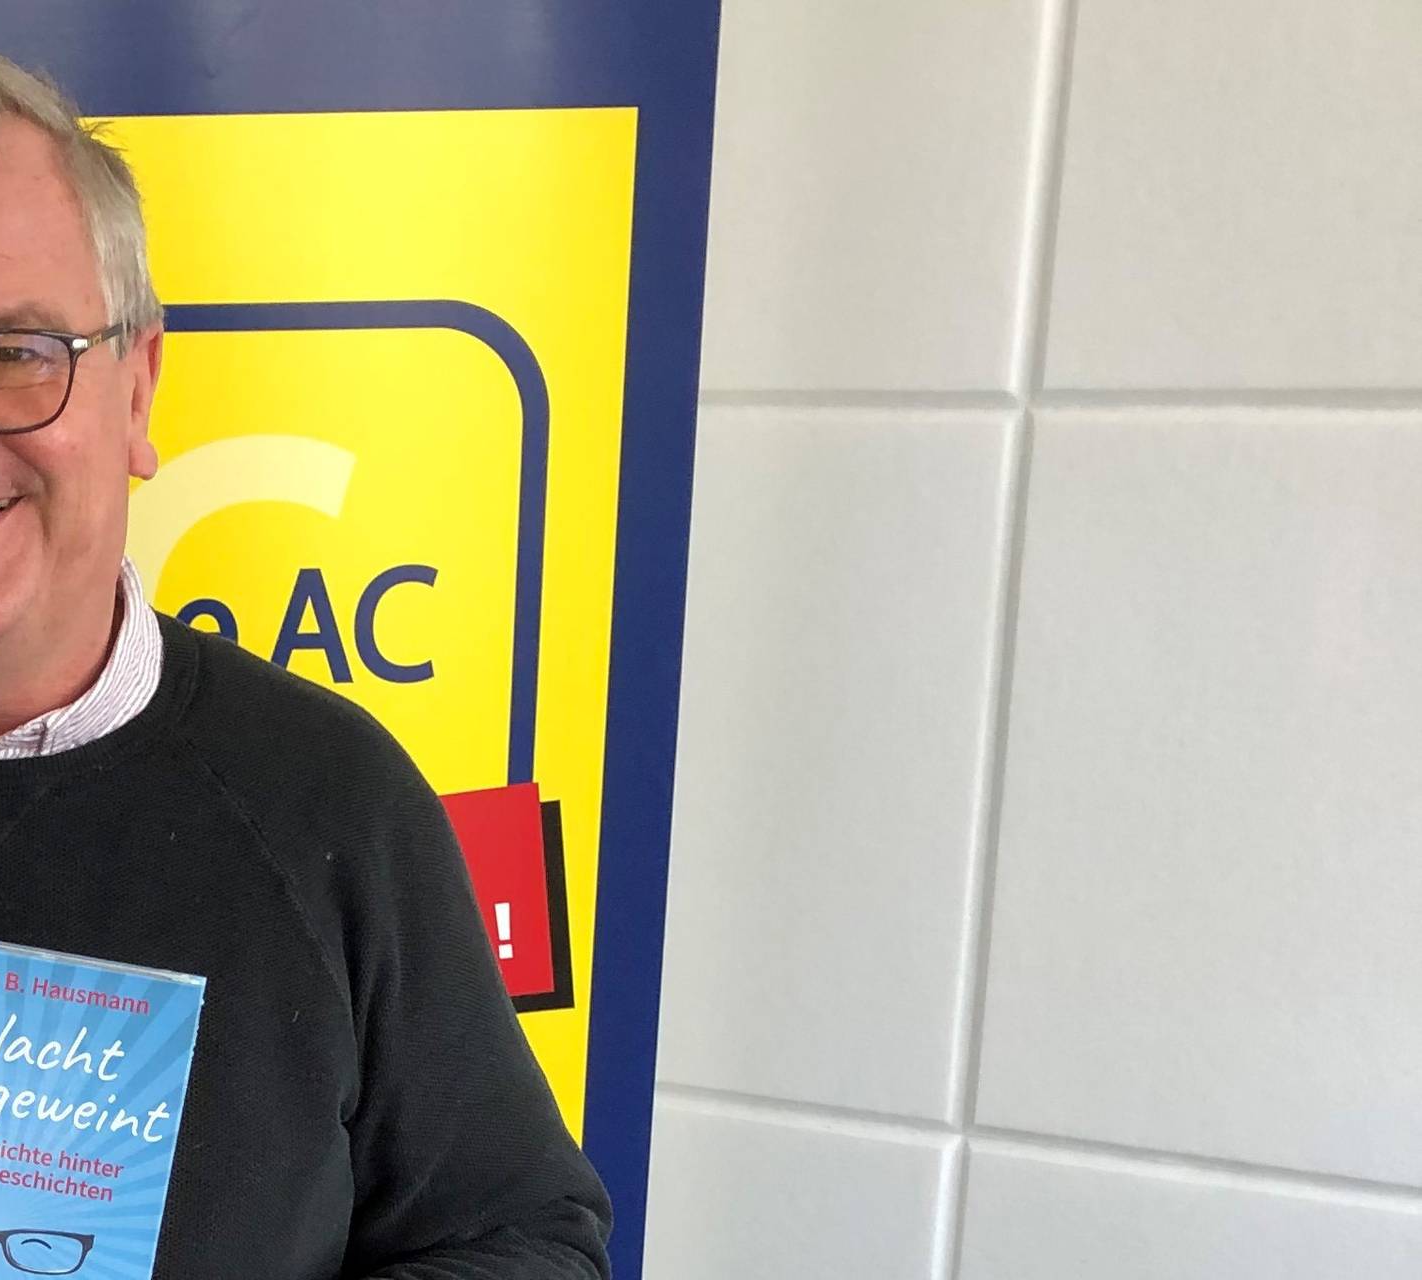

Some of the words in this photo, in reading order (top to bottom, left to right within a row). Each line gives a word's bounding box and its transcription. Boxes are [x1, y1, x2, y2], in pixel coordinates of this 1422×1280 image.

[270, 564, 438, 683] AC
[5, 973, 25, 993] B.
[32, 977, 150, 1015] Hausmann
[59, 1150, 124, 1179] hinter
